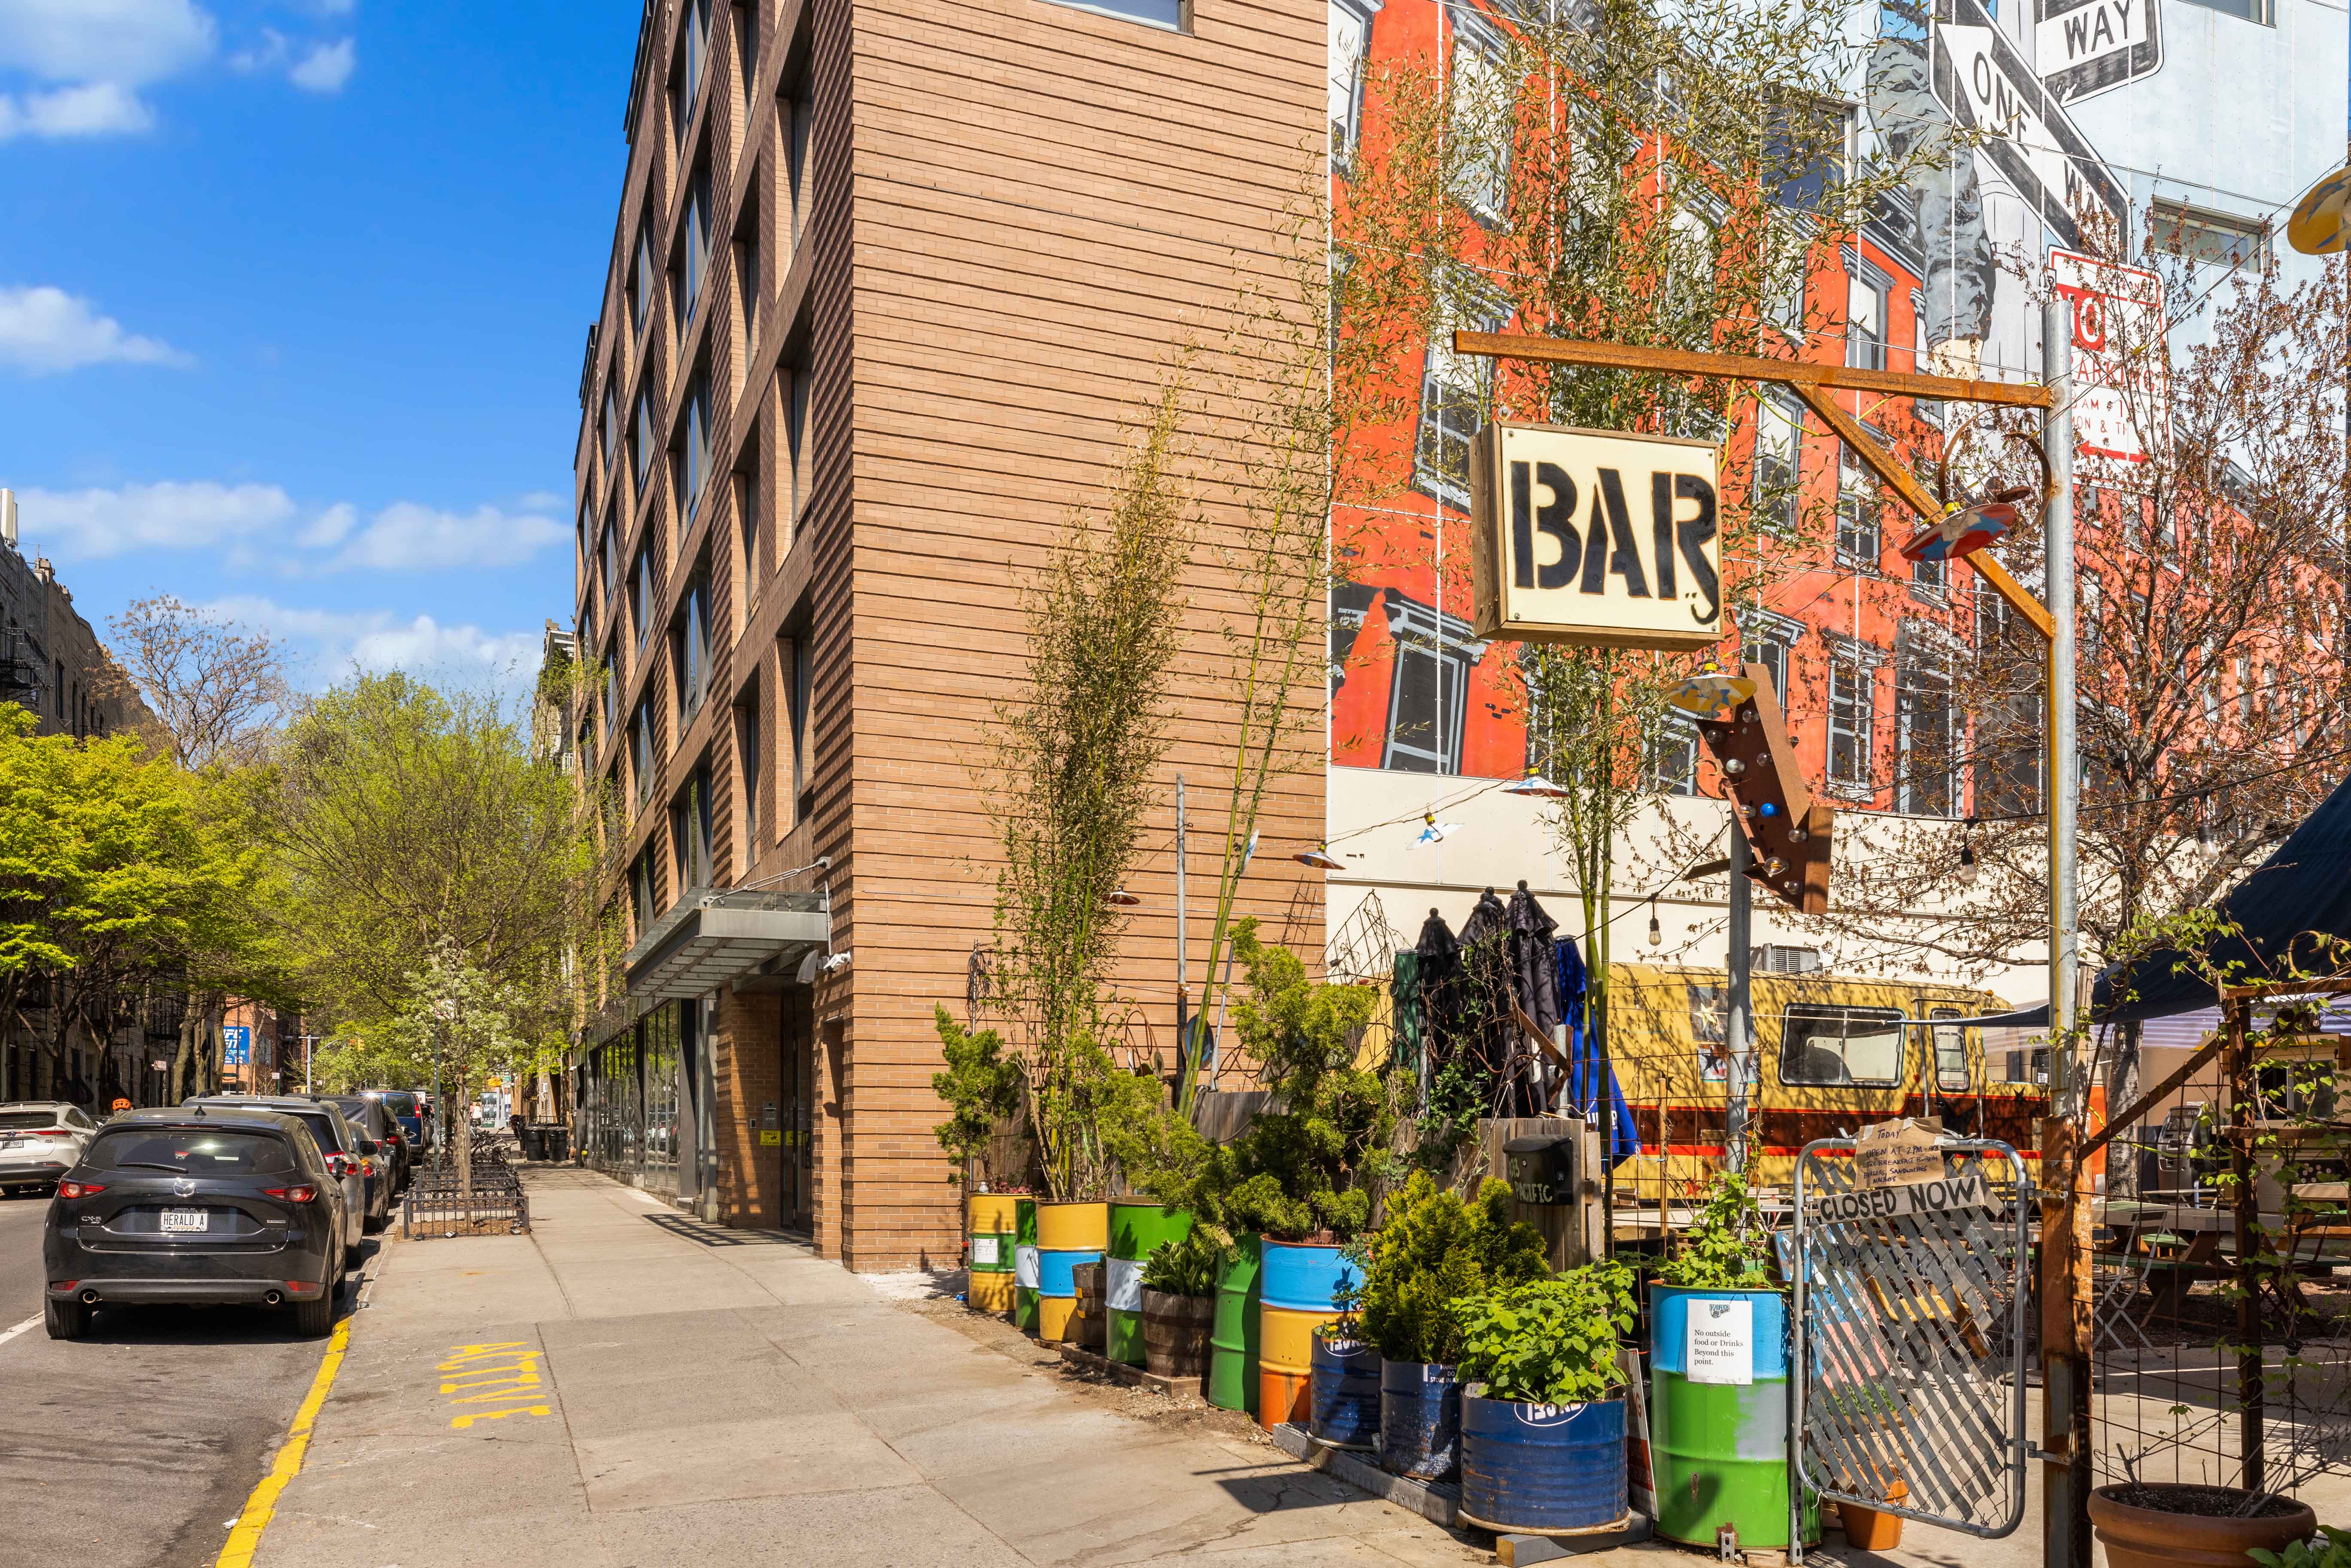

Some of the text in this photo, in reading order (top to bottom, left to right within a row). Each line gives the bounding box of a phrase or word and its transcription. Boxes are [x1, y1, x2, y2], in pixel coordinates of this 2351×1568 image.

[2064, 0, 2134, 60] WAY
[1974, 51, 2030, 158] ONE
[1510, 460, 1720, 625] BAR
[1877, 1128, 1901, 1139] TODAY
[1866, 1147, 1887, 1159] OPEN
[1891, 1146, 1902, 1155] AT
[1879, 1157, 1916, 1166] BREAKFAST
[1889, 1165, 1928, 1174] SANDWICHES
[1514, 1181, 1553, 1203] PACIFIC
[1820, 1177, 1976, 1221] CLOSED NOW
[164, 1214, 204, 1226] HERALD A
[1694, 1349, 1719, 1357] Beyond
